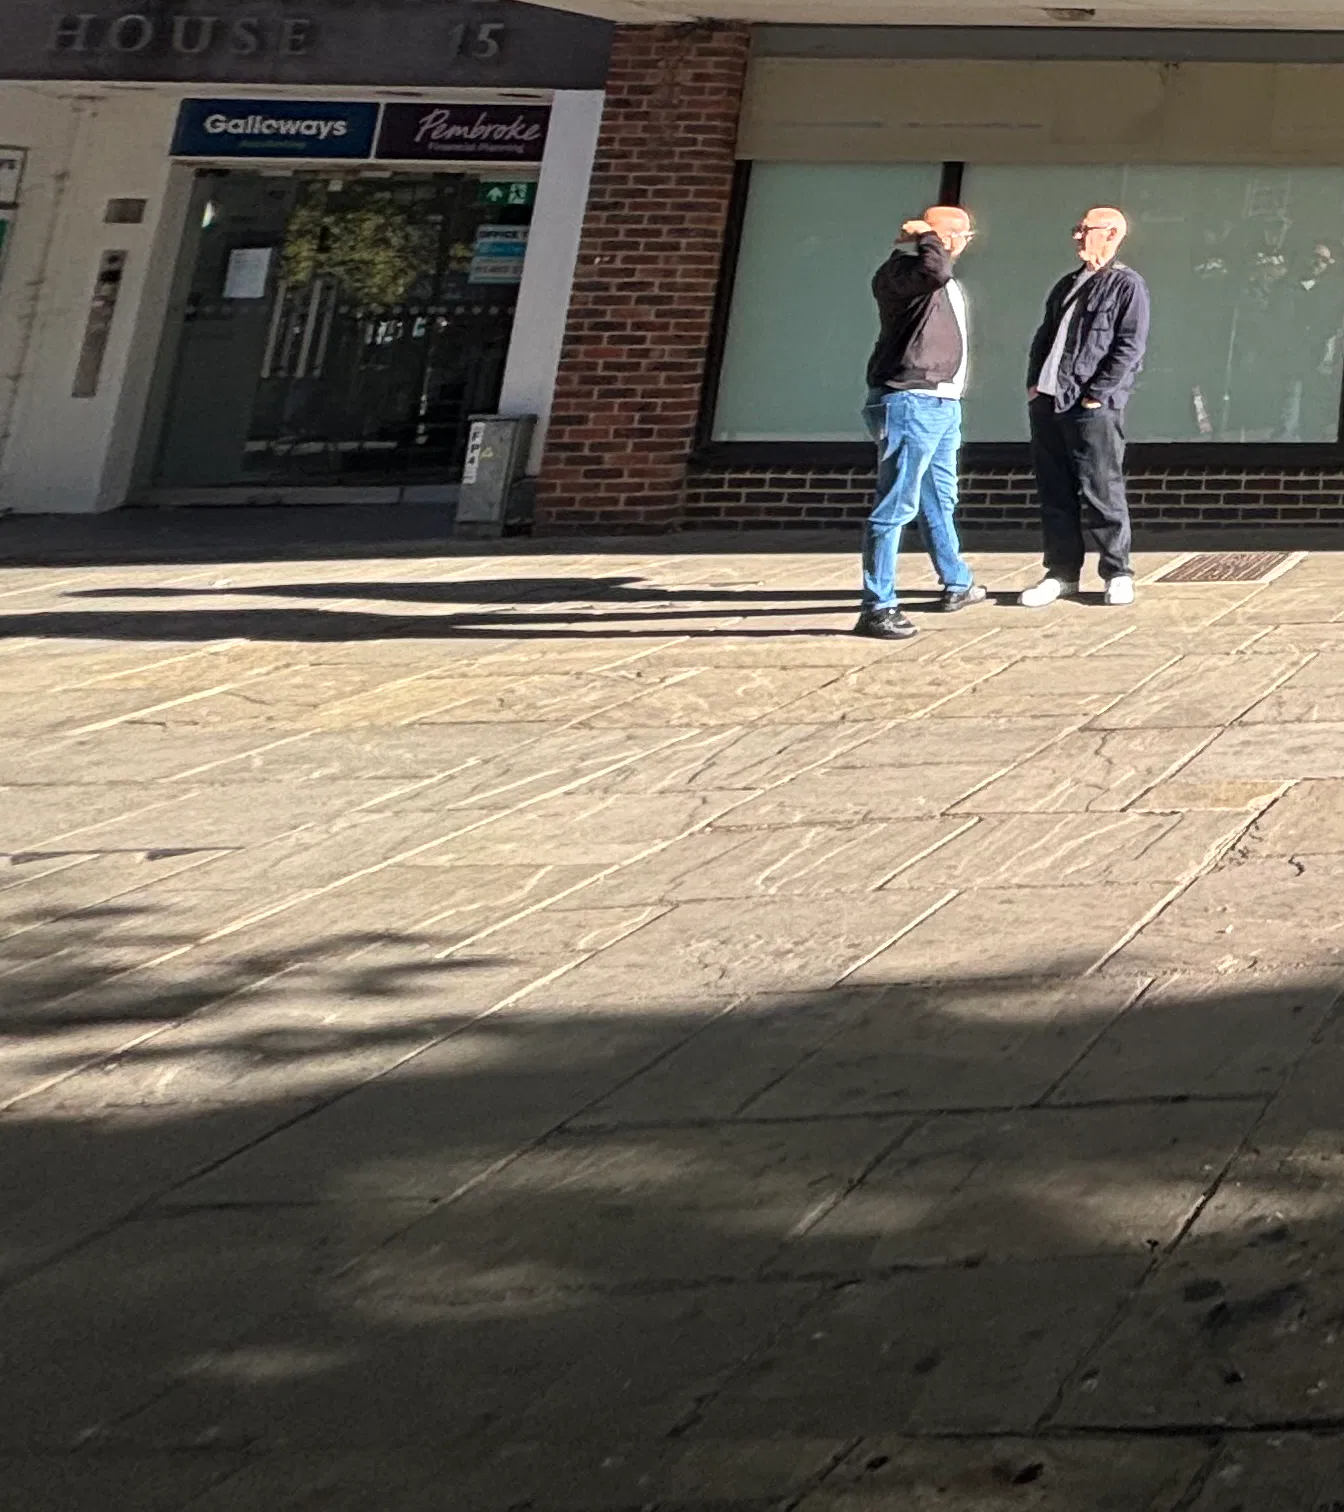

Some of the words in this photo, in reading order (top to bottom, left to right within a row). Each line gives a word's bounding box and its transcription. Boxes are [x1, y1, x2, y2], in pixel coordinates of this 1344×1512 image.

[50, 14, 310, 56] HOUSE
[452, 23, 504, 59] 15
[204, 114, 348, 140] Galloways
[414, 108, 541, 143] Pembroke
